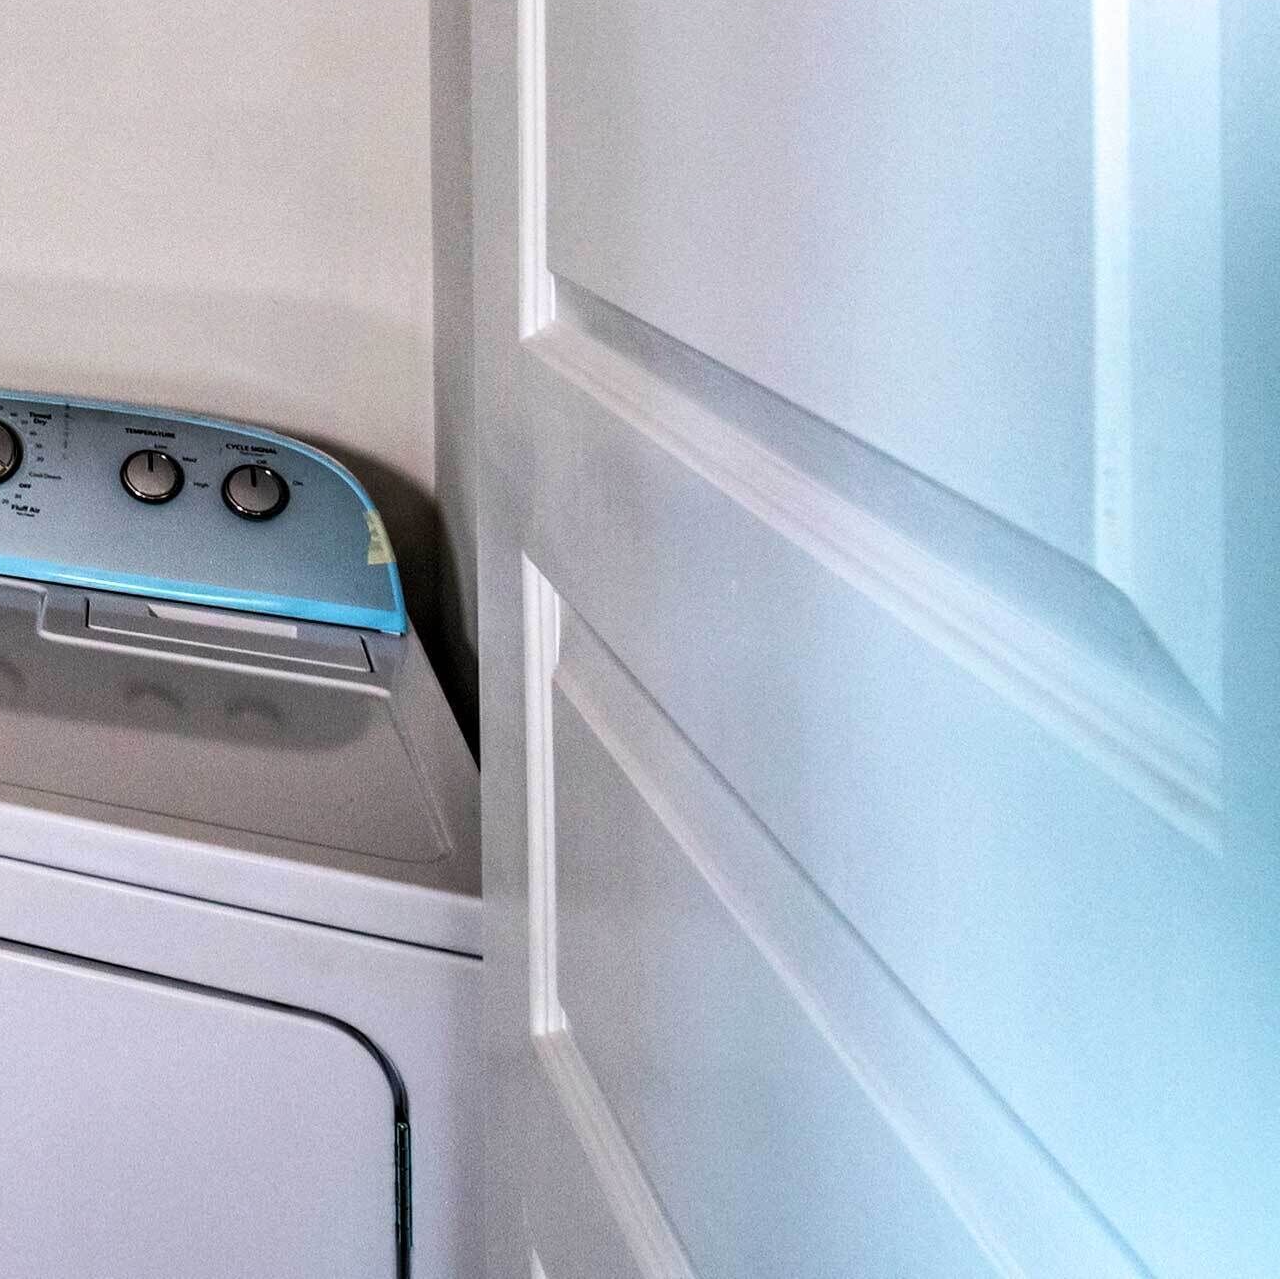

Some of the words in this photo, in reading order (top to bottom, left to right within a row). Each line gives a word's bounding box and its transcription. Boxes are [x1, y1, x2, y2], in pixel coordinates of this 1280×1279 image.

[125, 427, 176, 439] TEMPERATURE
[225, 443, 250, 452] CYCLE
[250, 445, 277, 454] SIGNAL
[11, 504, 29, 512] Fluff
[29, 505, 41, 514] Air
